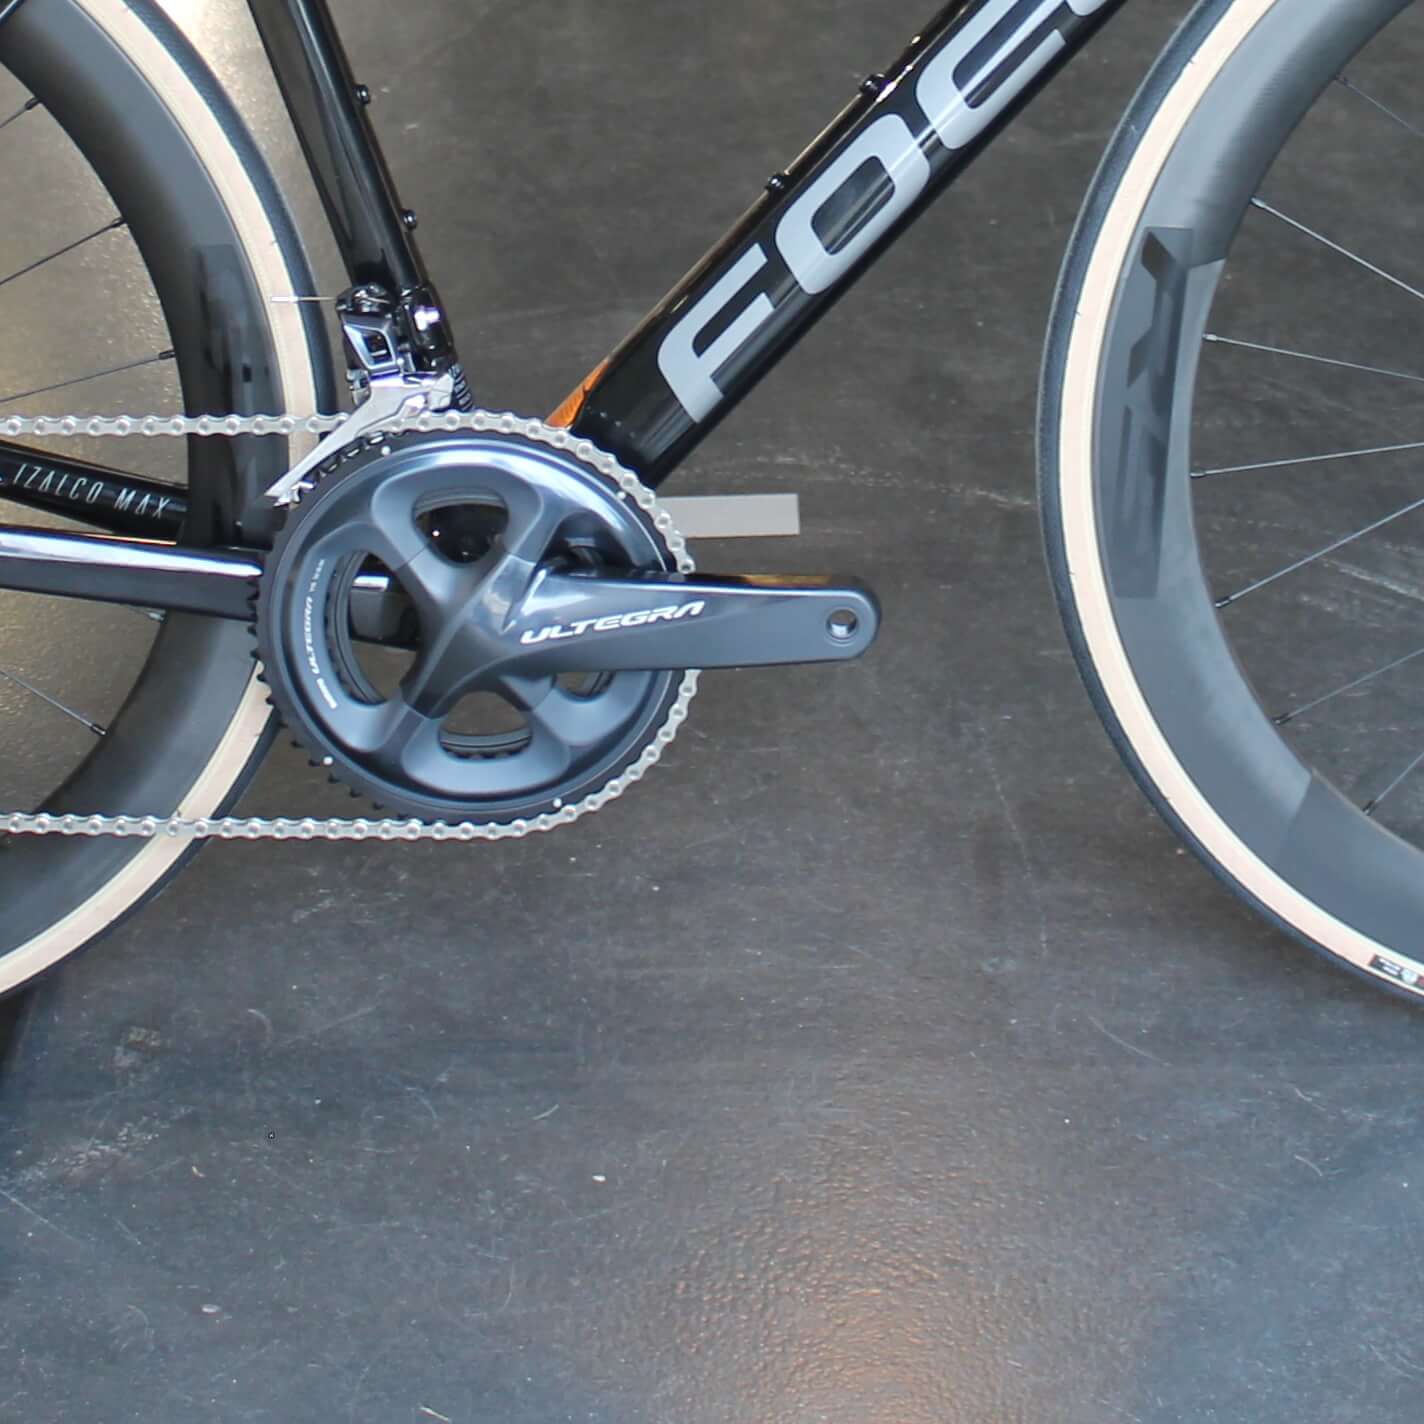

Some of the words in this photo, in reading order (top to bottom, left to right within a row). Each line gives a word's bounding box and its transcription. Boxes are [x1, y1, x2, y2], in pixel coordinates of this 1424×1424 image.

[13, 463, 105, 505] IZALCO
[113, 487, 172, 519] MAX
[519, 600, 706, 645] ULTEGRA
